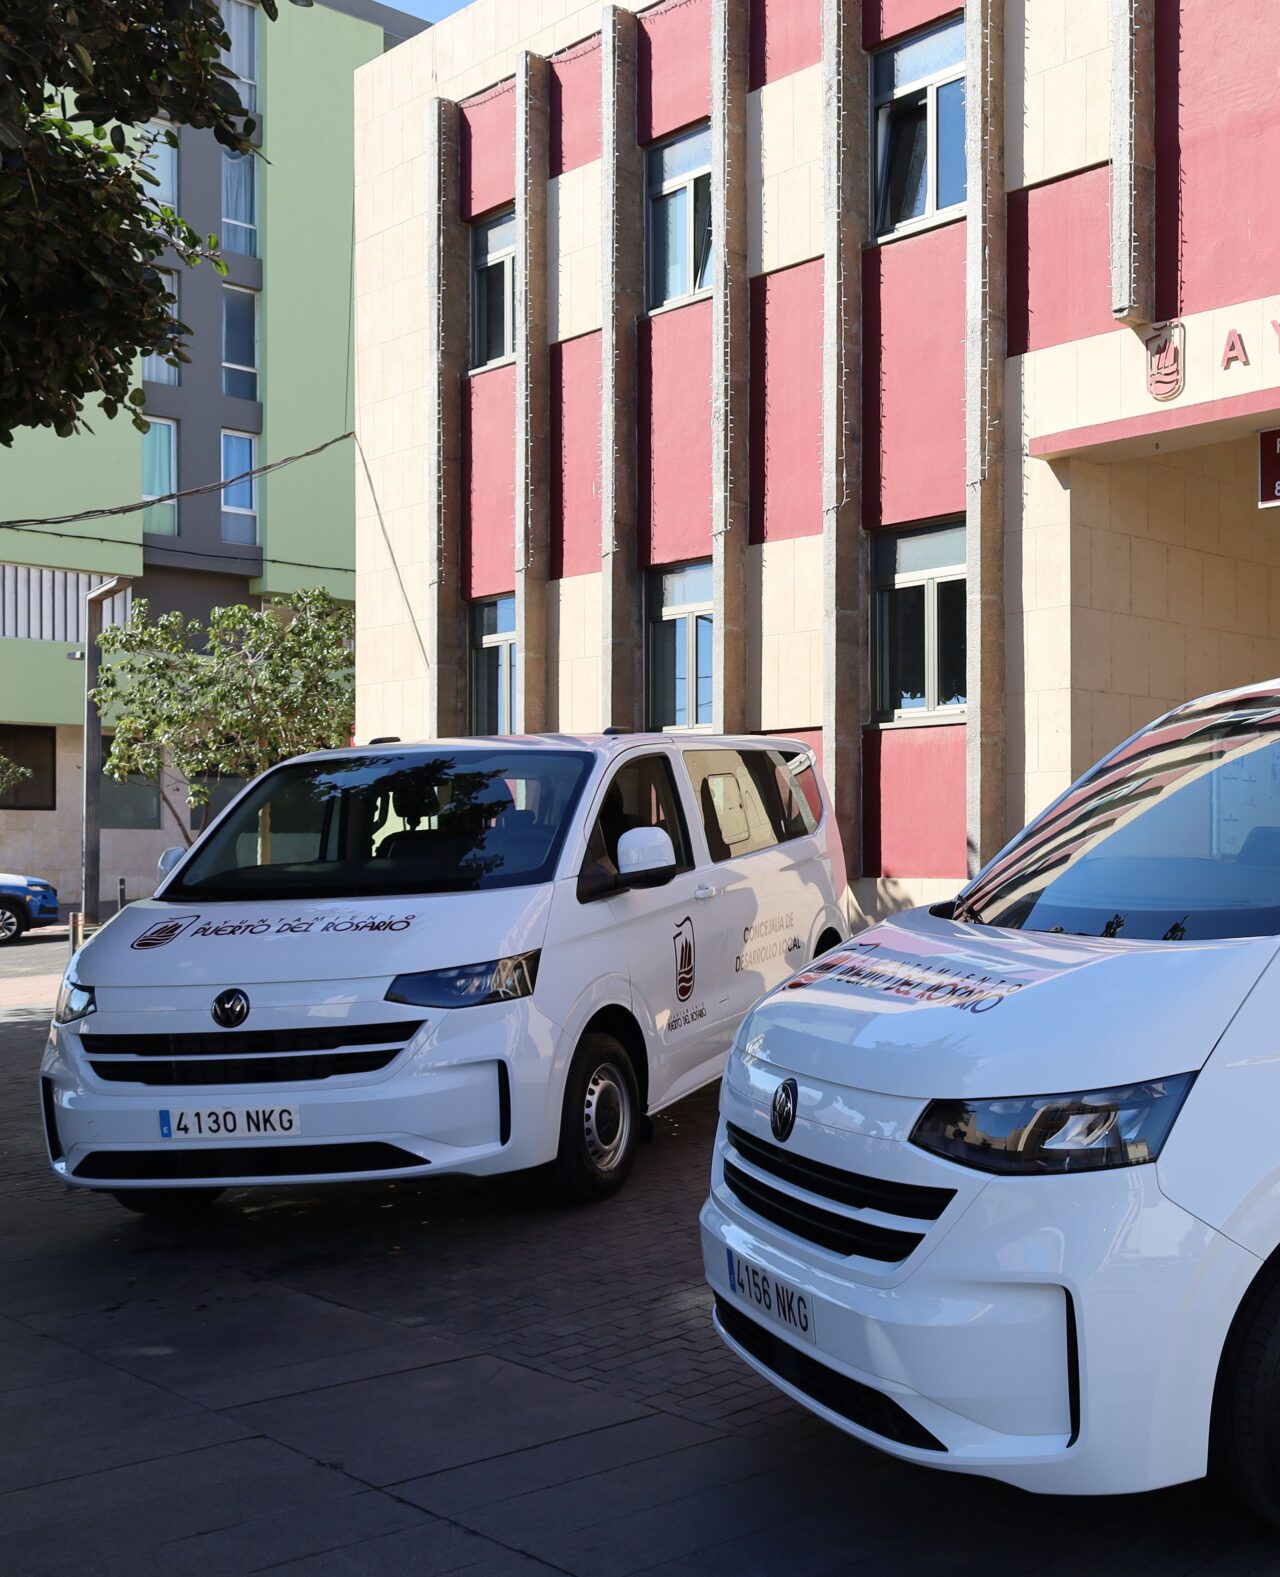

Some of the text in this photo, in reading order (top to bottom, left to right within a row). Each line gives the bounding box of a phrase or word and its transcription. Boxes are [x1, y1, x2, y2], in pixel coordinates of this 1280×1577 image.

[190, 920, 411, 938] PUERTO DEL ROSARIO
[203, 914, 416, 927] AYUNTAMIENTO
[786, 911, 794, 929] DE
[735, 935, 801, 973] DESARROLLO LOCAL
[176, 1111, 237, 1135] 4130
[245, 1109, 293, 1133] NKG
[737, 1259, 809, 1332] 4156 NKG
